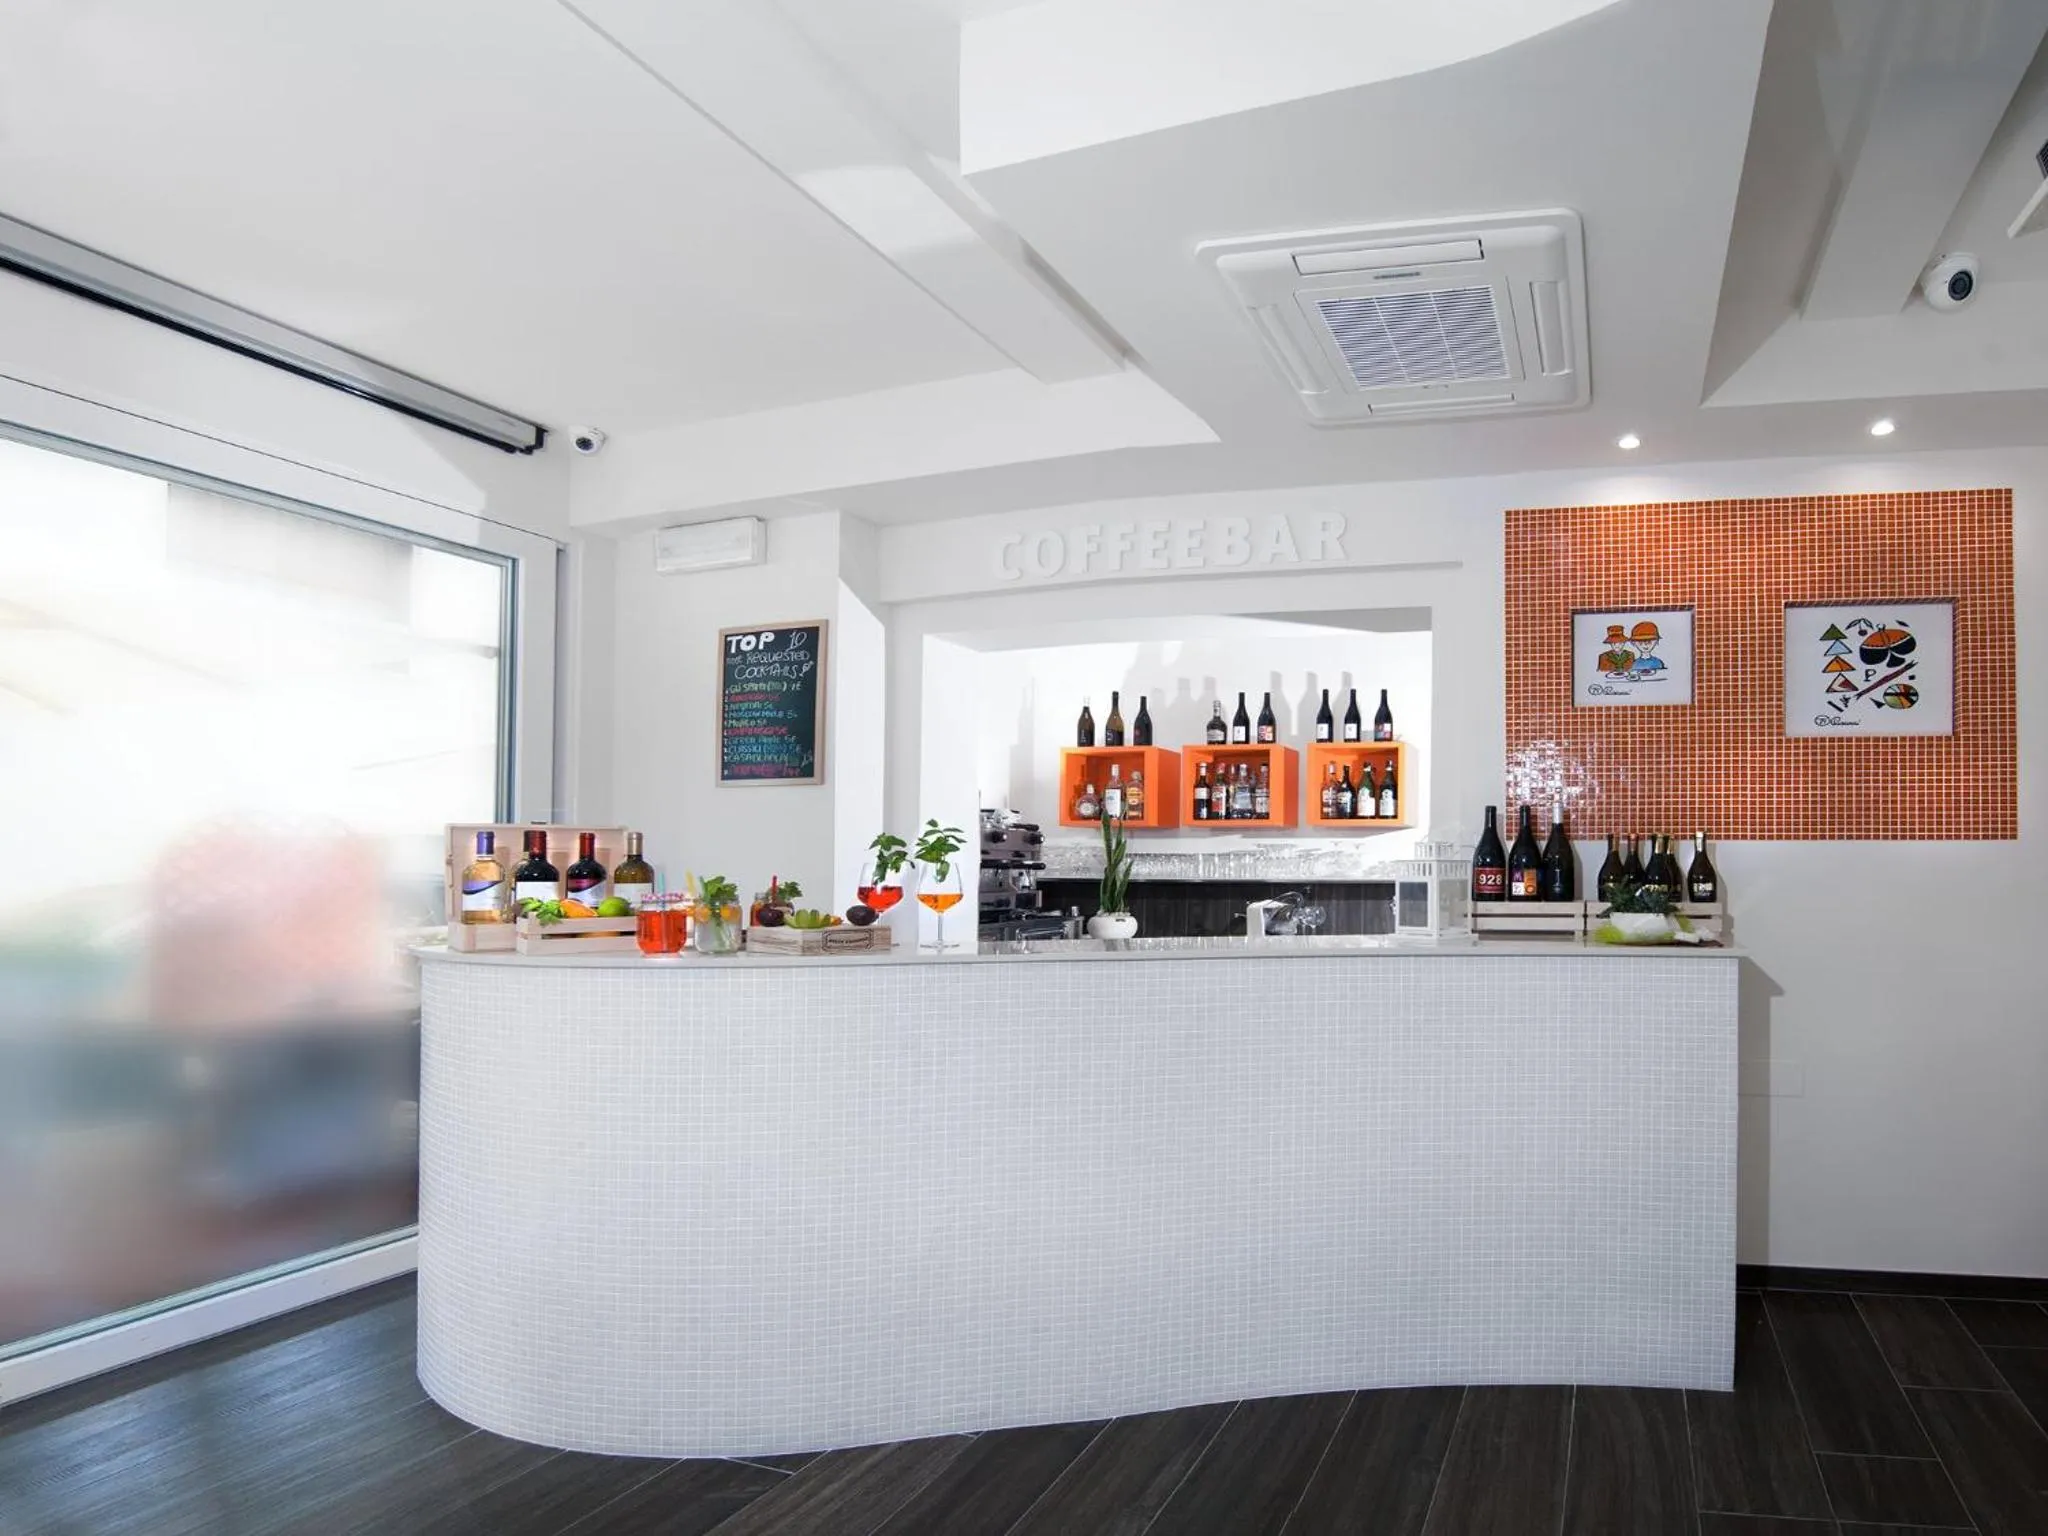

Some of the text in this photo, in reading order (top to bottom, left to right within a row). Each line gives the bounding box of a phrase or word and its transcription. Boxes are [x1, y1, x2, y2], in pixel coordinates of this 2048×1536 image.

[997, 511, 1349, 581] COFFEEBAR
[727, 630, 808, 654] TOP 10
[1863, 668, 1877, 682] P
[1479, 873, 1503, 885] 928
